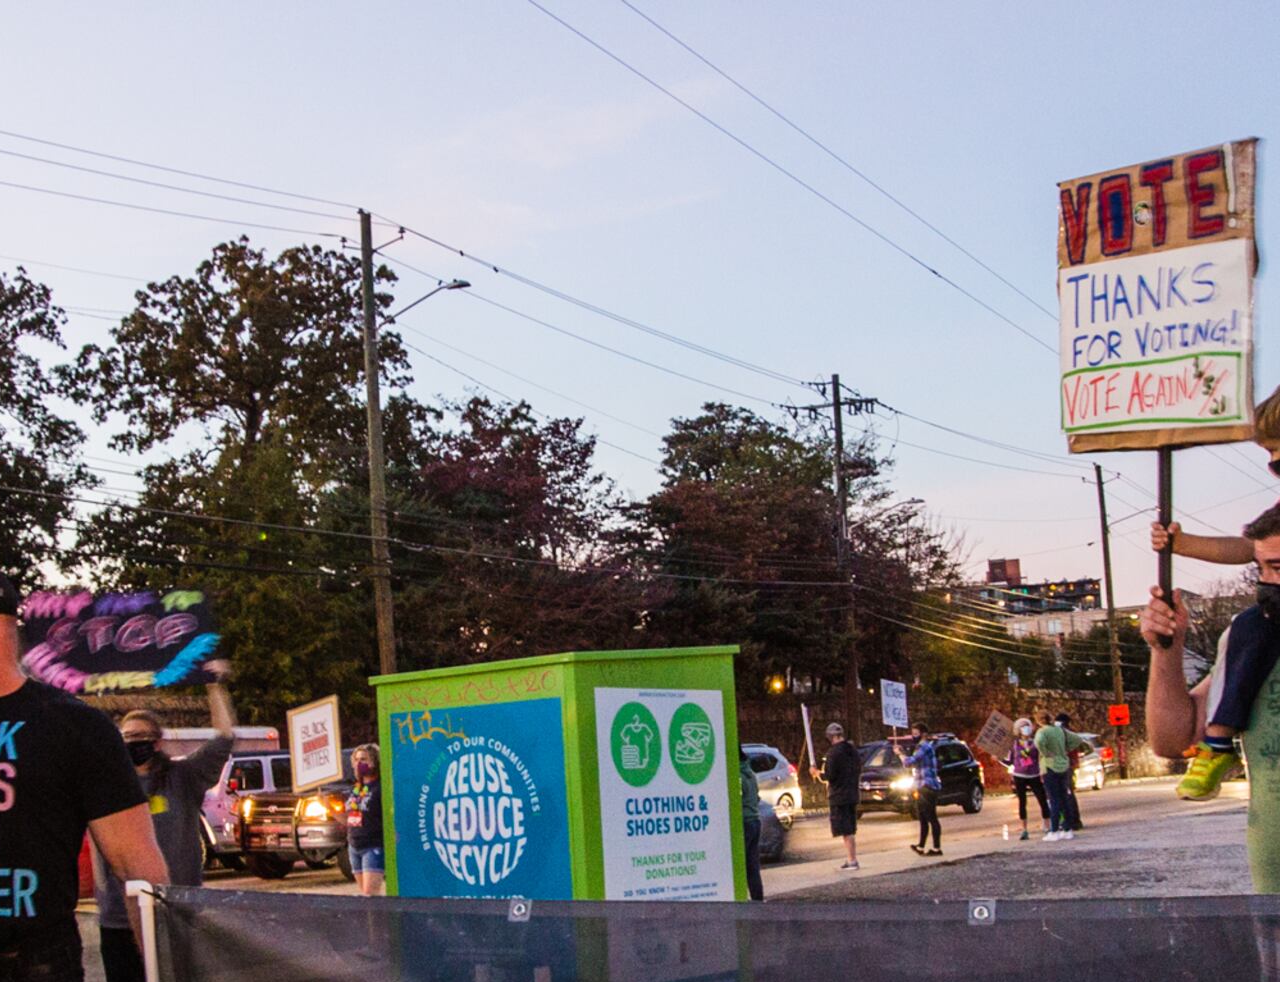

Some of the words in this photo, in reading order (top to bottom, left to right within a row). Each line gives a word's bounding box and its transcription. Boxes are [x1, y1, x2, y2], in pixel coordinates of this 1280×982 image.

[1060, 143, 1236, 266] VOTE!
[1067, 262, 1217, 328] THANKS
[1072, 330, 1122, 369] FOR
[1135, 309, 1239, 357] VOTING!
[1064, 371, 1121, 425] VOTE
[1127, 366, 1187, 415] AGAIN
[418, 784, 430, 850] BRINGING
[447, 741, 461, 756] TO
[463, 736, 485, 748] OUR
[443, 752, 513, 798] REUSE
[433, 796, 525, 842] REDUCE
[625, 795, 695, 815] CLOTHING
[698, 794, 709, 811] &
[626, 817, 671, 837] SHOES
[674, 815, 709, 832] DROP
[433, 836, 527, 886] RECYCLE
[631, 854, 666, 868] THANKS
[667, 852, 682, 866] FOR
[685, 851, 706, 864] YOUR
[645, 865, 698, 880] DONATIONS!
